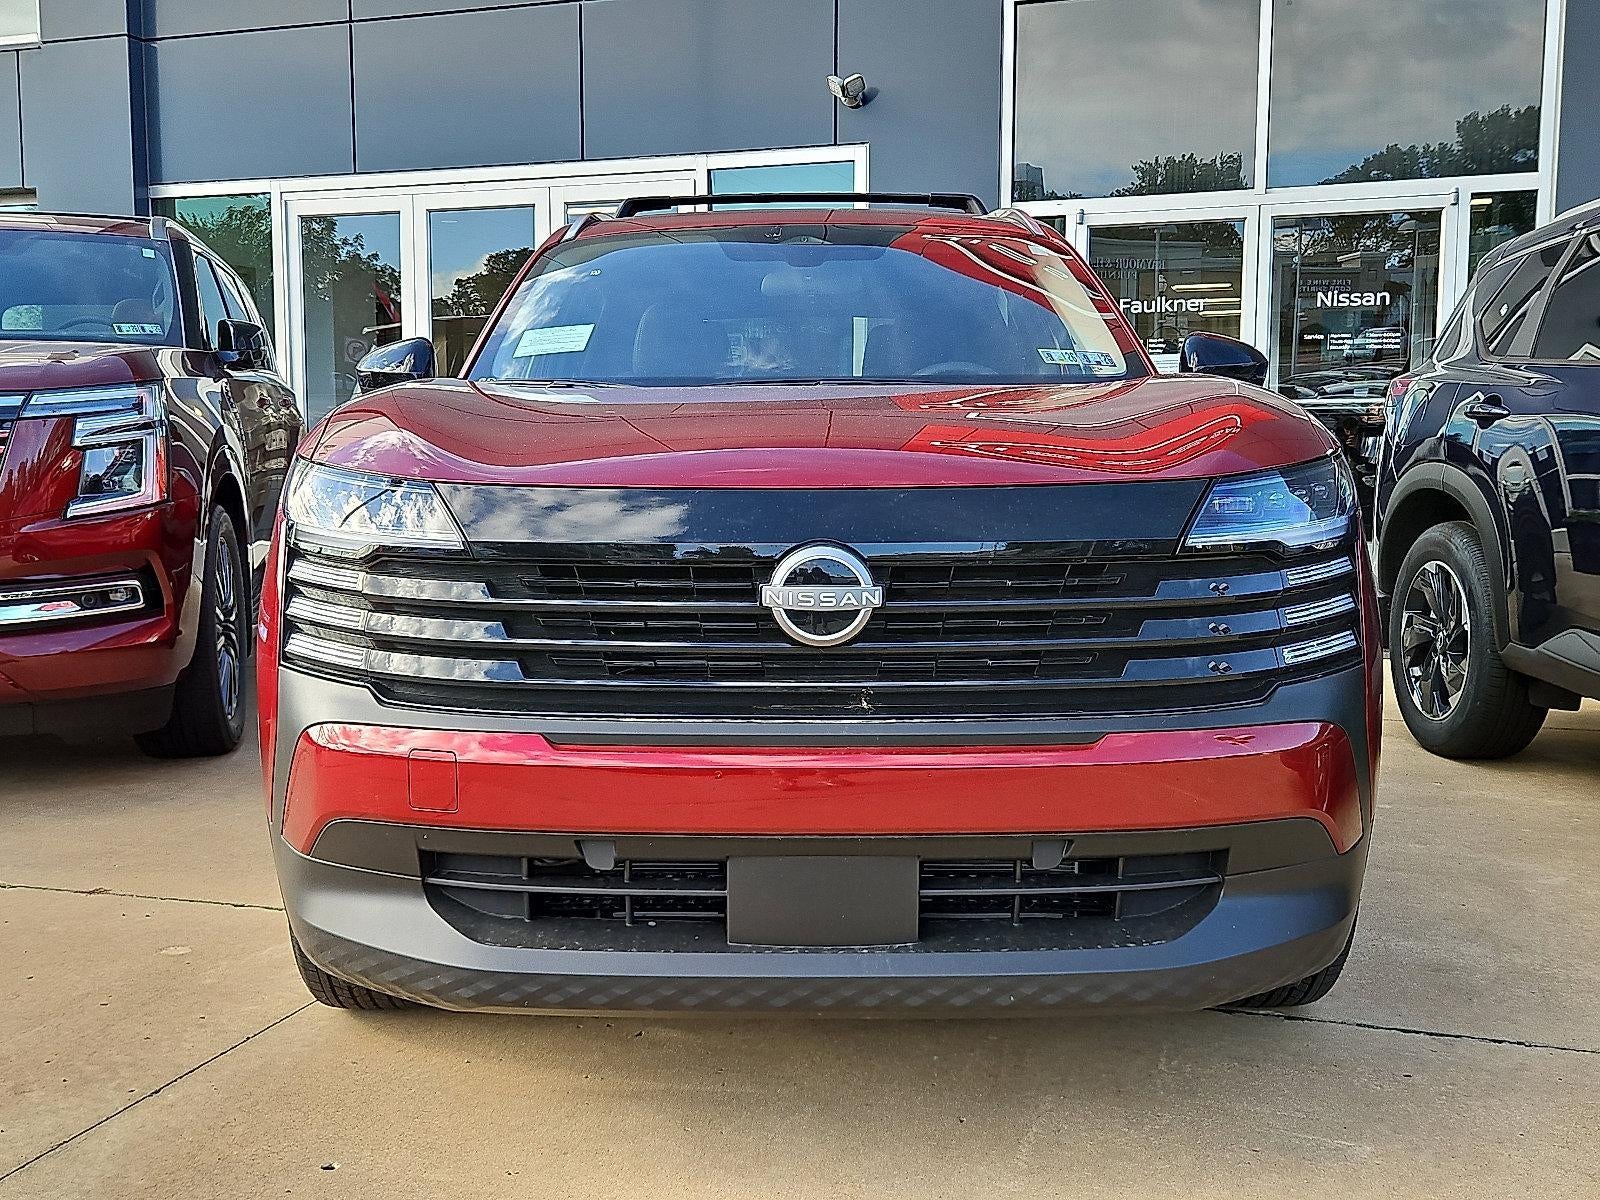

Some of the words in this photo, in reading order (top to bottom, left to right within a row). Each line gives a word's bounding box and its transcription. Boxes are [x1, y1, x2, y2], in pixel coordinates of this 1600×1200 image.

[1120, 296, 1207, 314] Faulkner
[1317, 290, 1391, 308] Nissan
[765, 590, 880, 607] NISSAN
